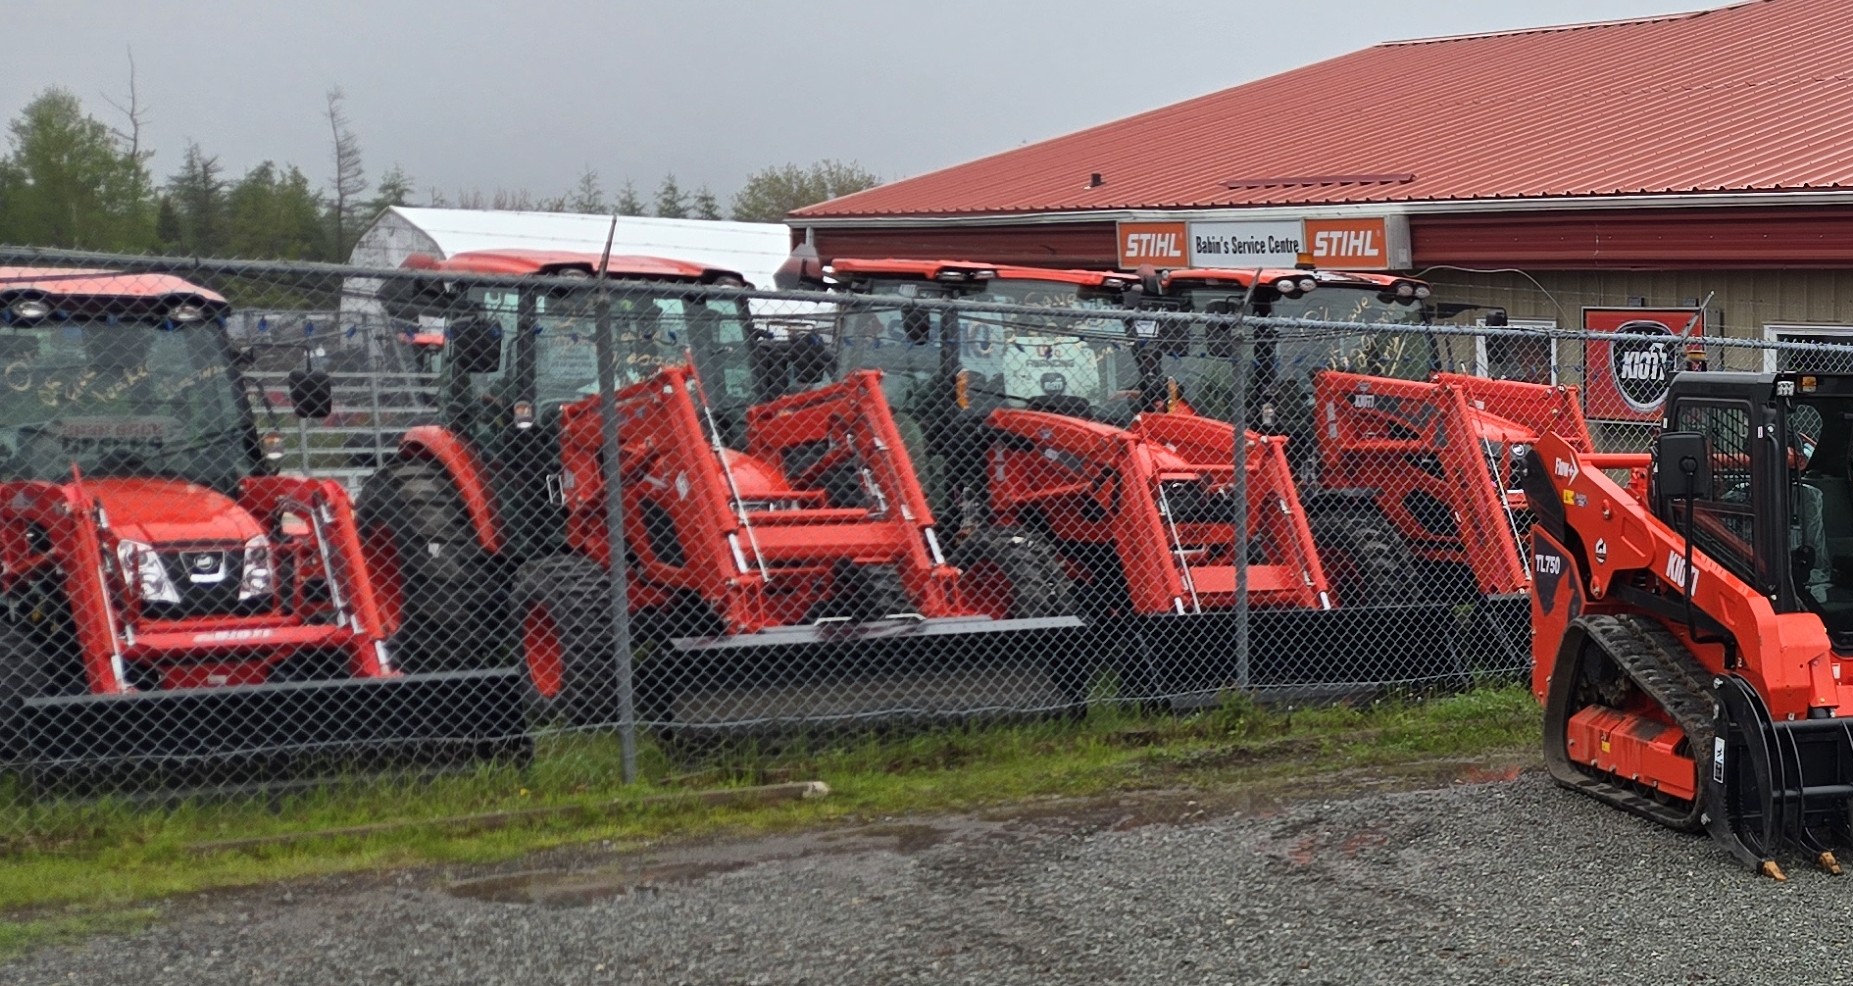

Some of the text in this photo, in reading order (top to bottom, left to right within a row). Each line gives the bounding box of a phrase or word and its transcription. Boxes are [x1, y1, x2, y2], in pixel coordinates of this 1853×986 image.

[1126, 233, 1181, 257] STIHL
[1196, 235, 1299, 255] Babin's Service Centre
[1314, 230, 1379, 257] STIHL
[1621, 351, 1668, 380] KIOTI
[1535, 554, 1561, 574] TL750
